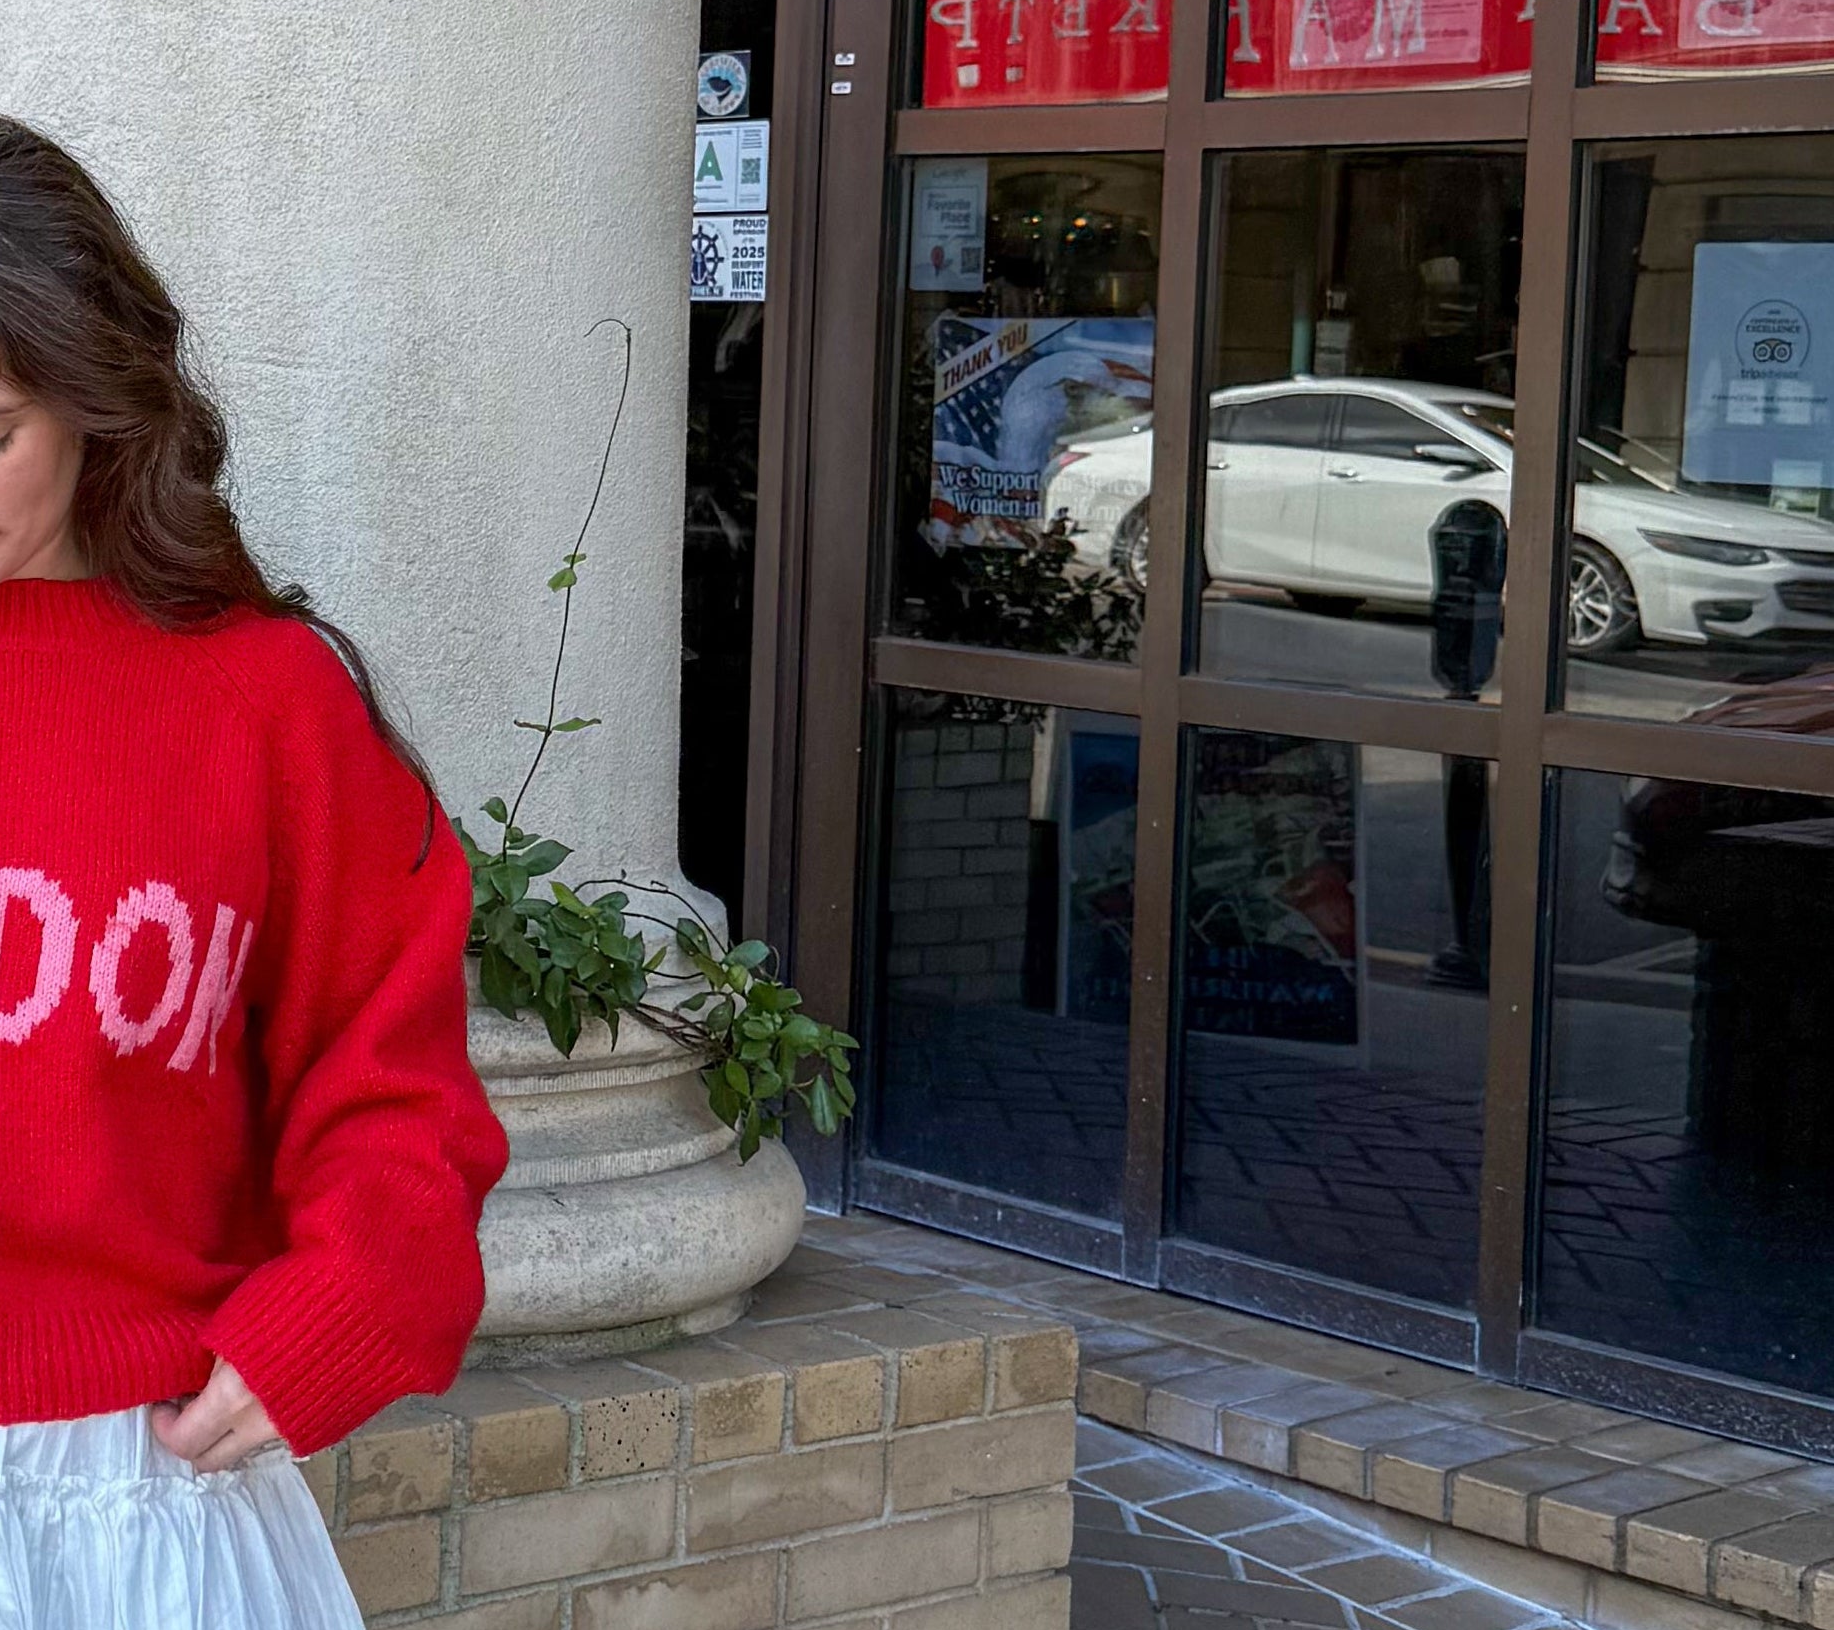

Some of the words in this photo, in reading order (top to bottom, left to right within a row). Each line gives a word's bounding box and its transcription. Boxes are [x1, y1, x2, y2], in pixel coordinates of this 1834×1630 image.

[695, 139, 724, 182] A
[733, 218, 766, 228] PROUD
[941, 212, 971, 223] Place
[732, 246, 765, 259] 2025
[731, 271, 764, 290] WATER
[1745, 324, 1801, 334] EXCELLENCE
[942, 347, 994, 392] THANK
[997, 323, 1028, 356] YOU
[938, 465, 967, 488] We
[971, 466, 1040, 494] Support
[952, 491, 1024, 515] Women
[1025, 492, 1042, 516] in
